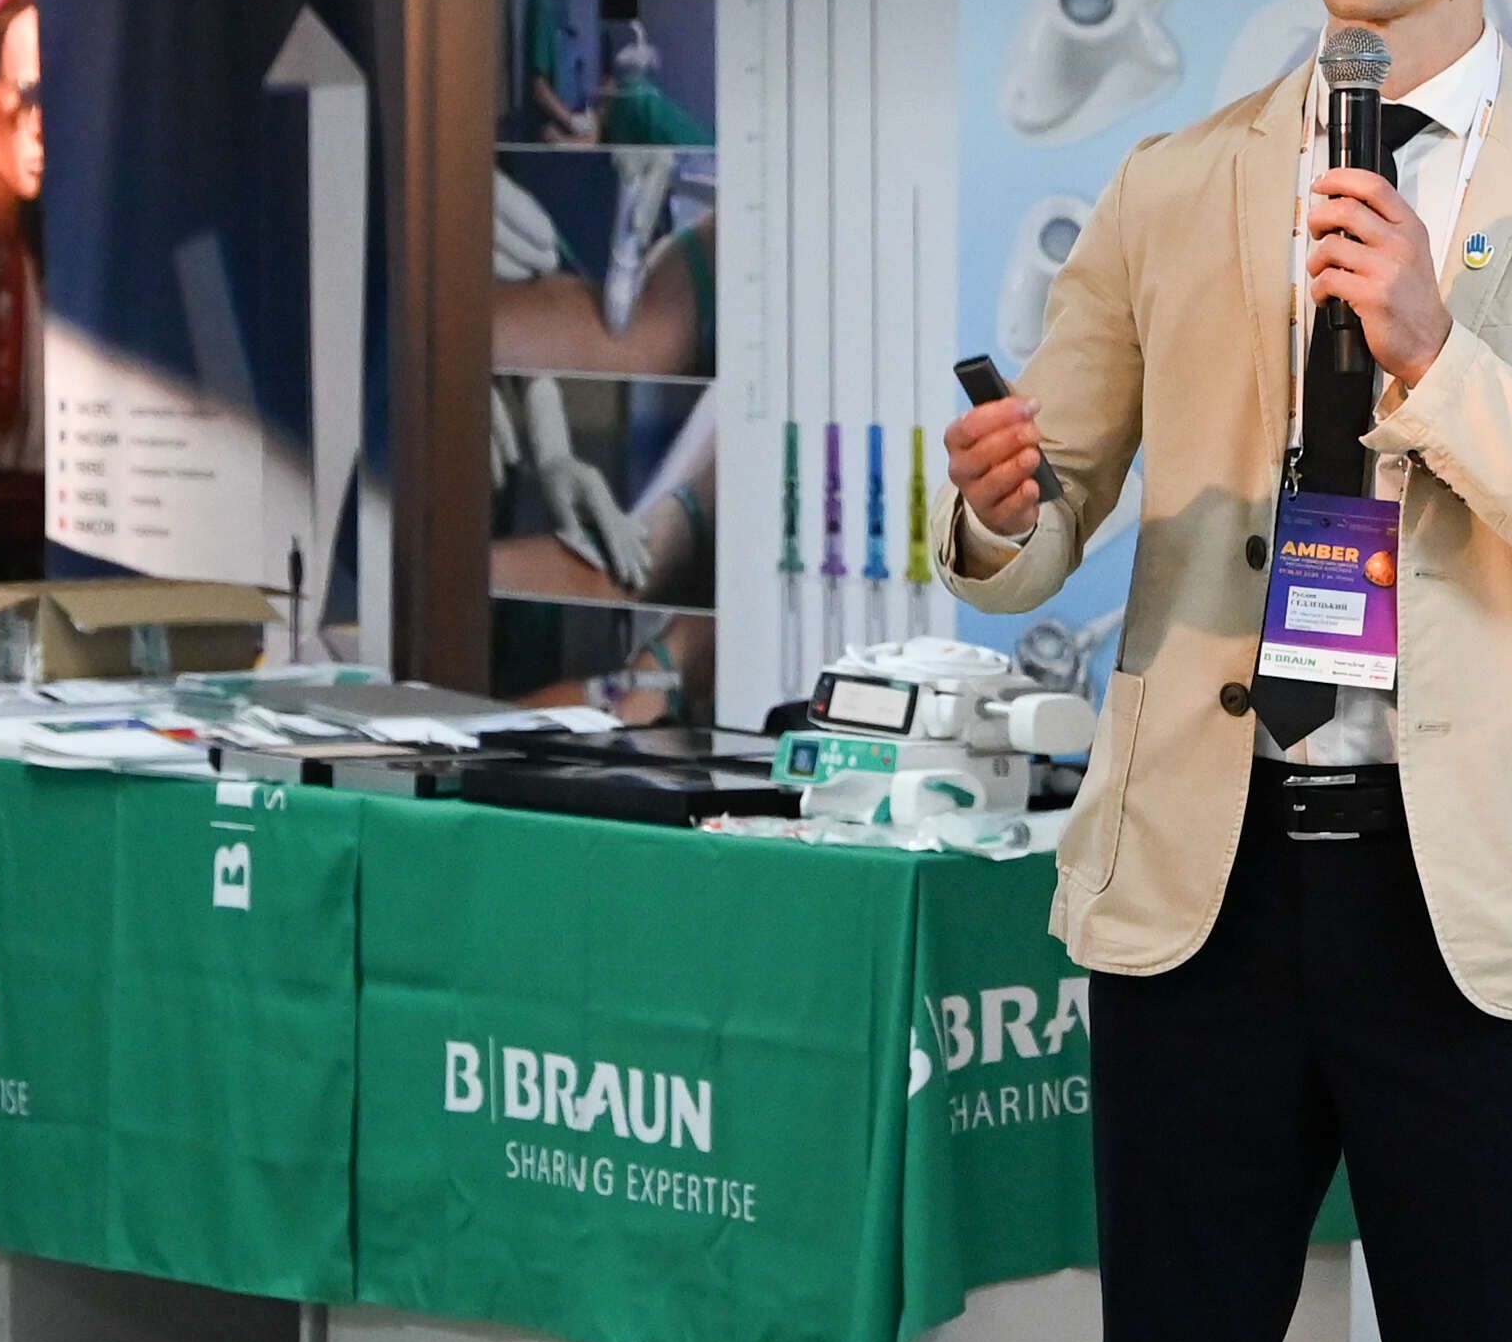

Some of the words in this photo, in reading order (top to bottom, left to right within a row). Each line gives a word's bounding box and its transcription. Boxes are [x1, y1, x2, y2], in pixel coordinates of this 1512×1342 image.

[1281, 541, 1361, 564] AMBER
[940, 977, 1090, 1073] BRA
[502, 1046, 713, 1153] BRAUN
[948, 1074, 1089, 1136] HARING
[626, 1163, 757, 1222] EXPERTISE
